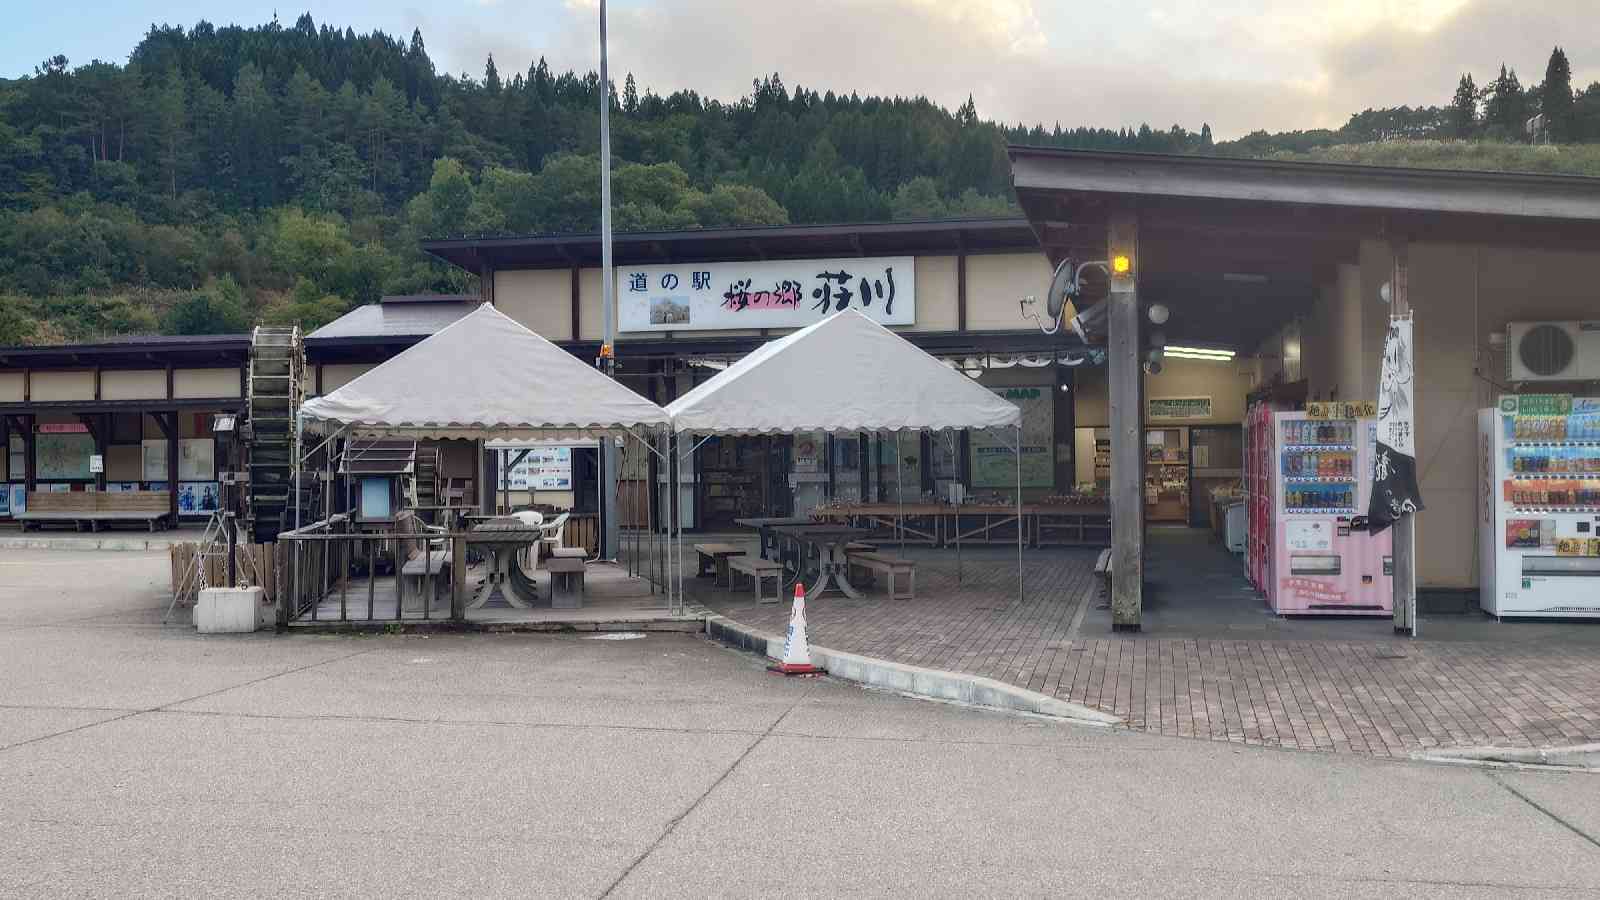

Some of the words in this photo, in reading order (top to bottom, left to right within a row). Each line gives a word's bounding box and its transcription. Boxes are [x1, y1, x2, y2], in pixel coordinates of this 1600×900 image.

[629, 271, 711, 292] 道の駅
[720, 278, 802, 312] 桜の郷
[811, 267, 895, 315] 荘川
